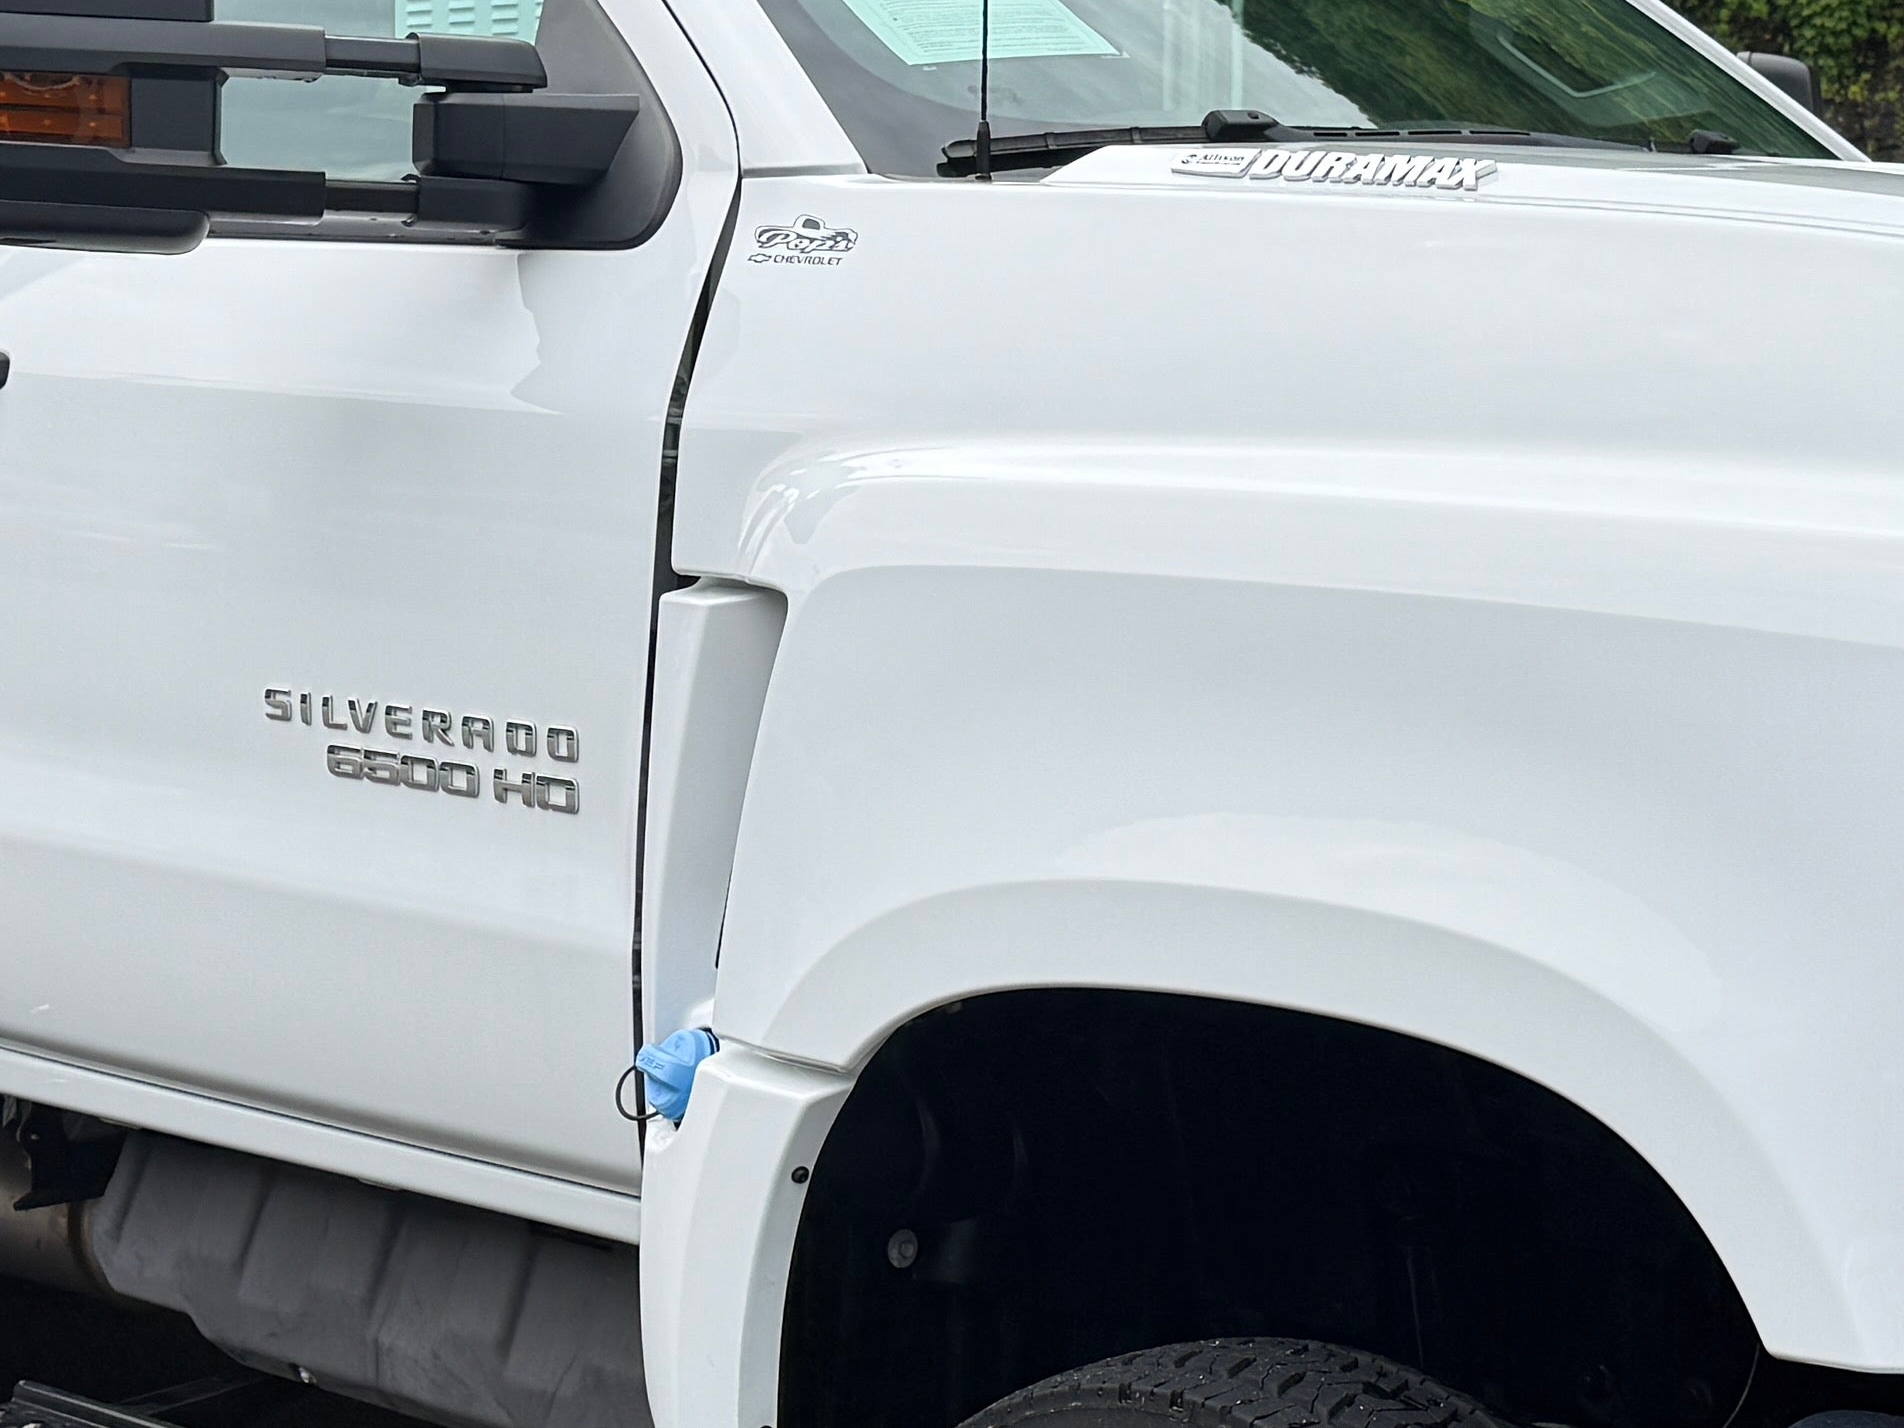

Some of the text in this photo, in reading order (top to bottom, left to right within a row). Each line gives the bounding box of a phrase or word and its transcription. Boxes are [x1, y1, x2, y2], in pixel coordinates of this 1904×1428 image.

[1249, 149, 1497, 191] DURAMAX
[773, 254, 843, 266] CHEVROLET
[264, 687, 579, 763] SILVERADO
[326, 743, 580, 815] 6500 HD
